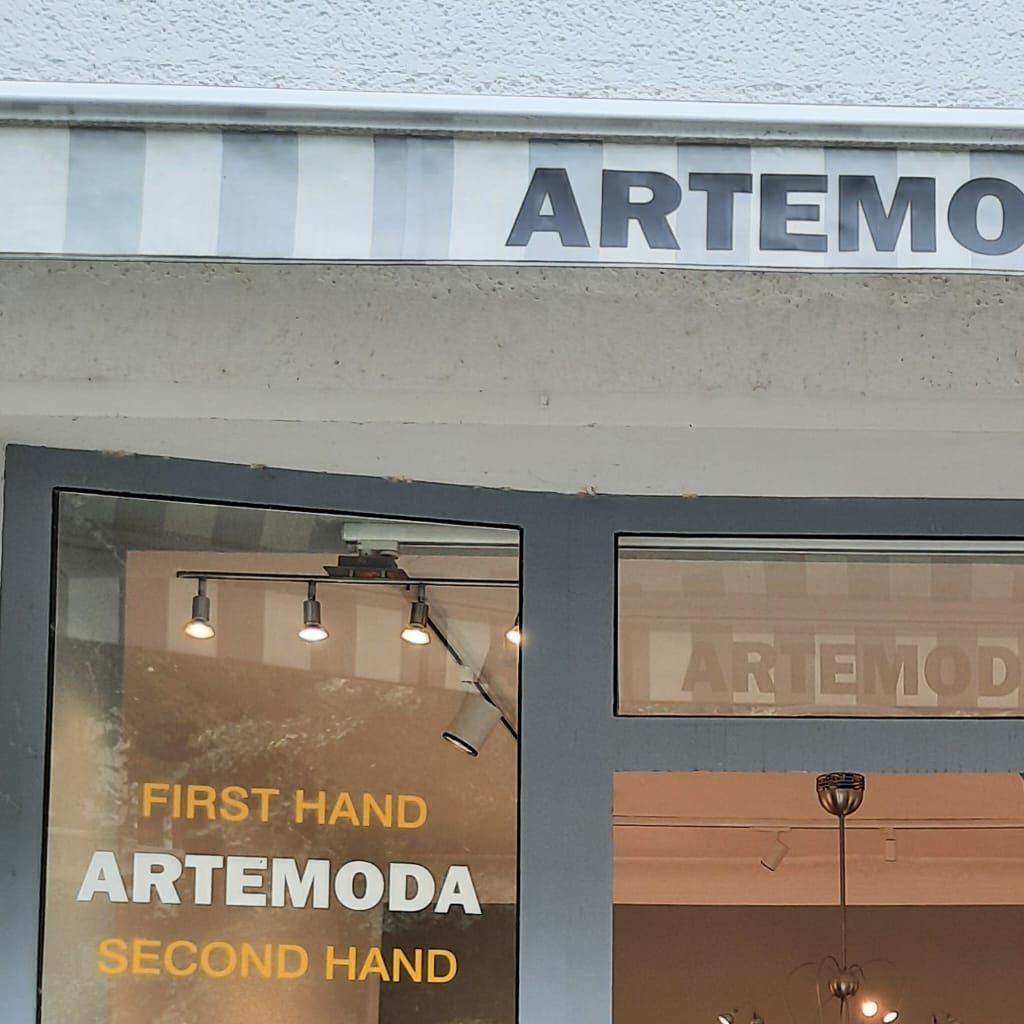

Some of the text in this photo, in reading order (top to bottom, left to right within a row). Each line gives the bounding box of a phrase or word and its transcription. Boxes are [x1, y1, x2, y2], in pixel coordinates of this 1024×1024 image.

[142, 782, 429, 830] FIRST HAND
[75, 850, 483, 915] ARTEMODA
[97, 937, 458, 984] SECOND HAND
